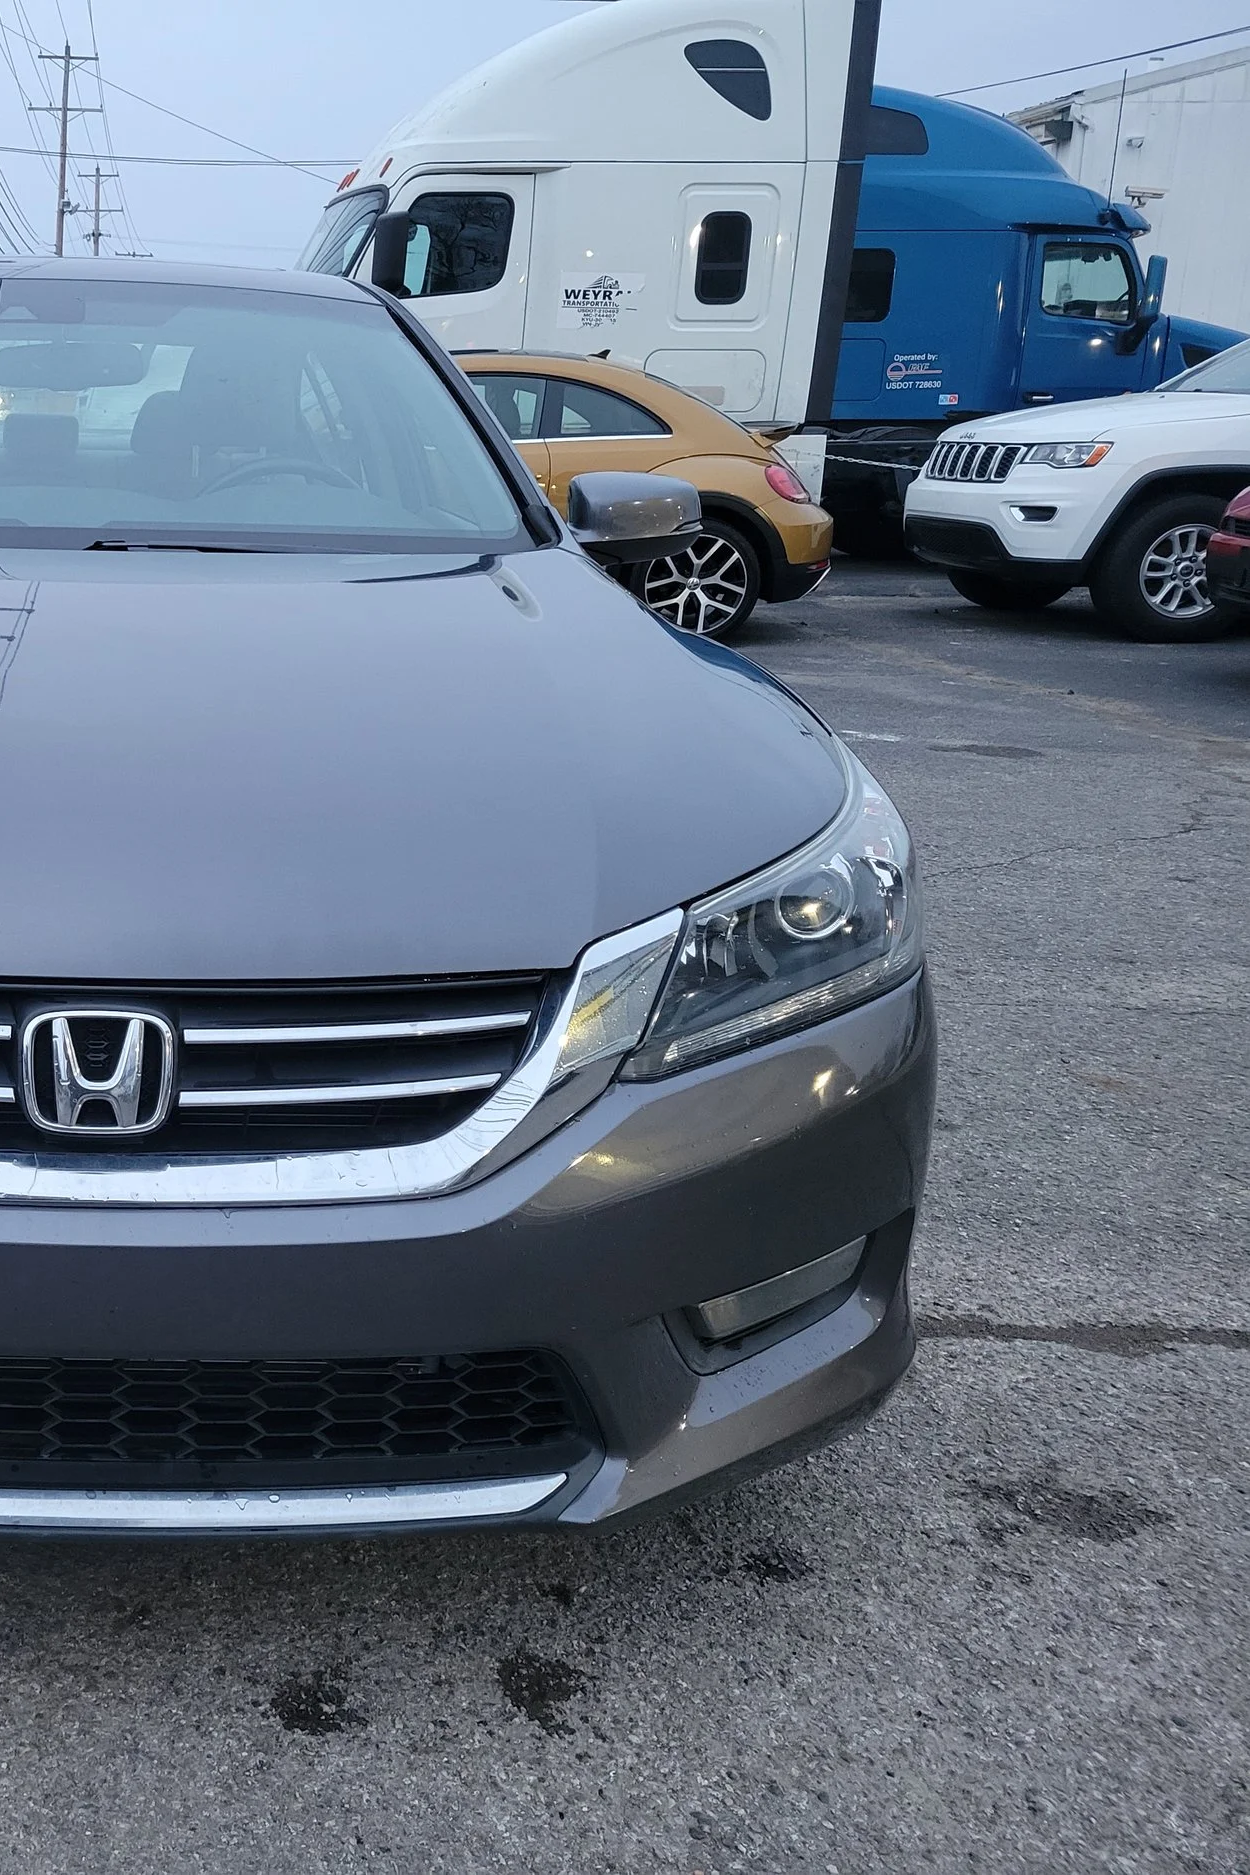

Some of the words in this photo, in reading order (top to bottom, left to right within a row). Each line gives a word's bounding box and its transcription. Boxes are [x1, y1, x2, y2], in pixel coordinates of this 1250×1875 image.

[893, 353, 926, 362] Operated
[927, 353, 938, 361] by:
[885, 382, 913, 390] USDOT
